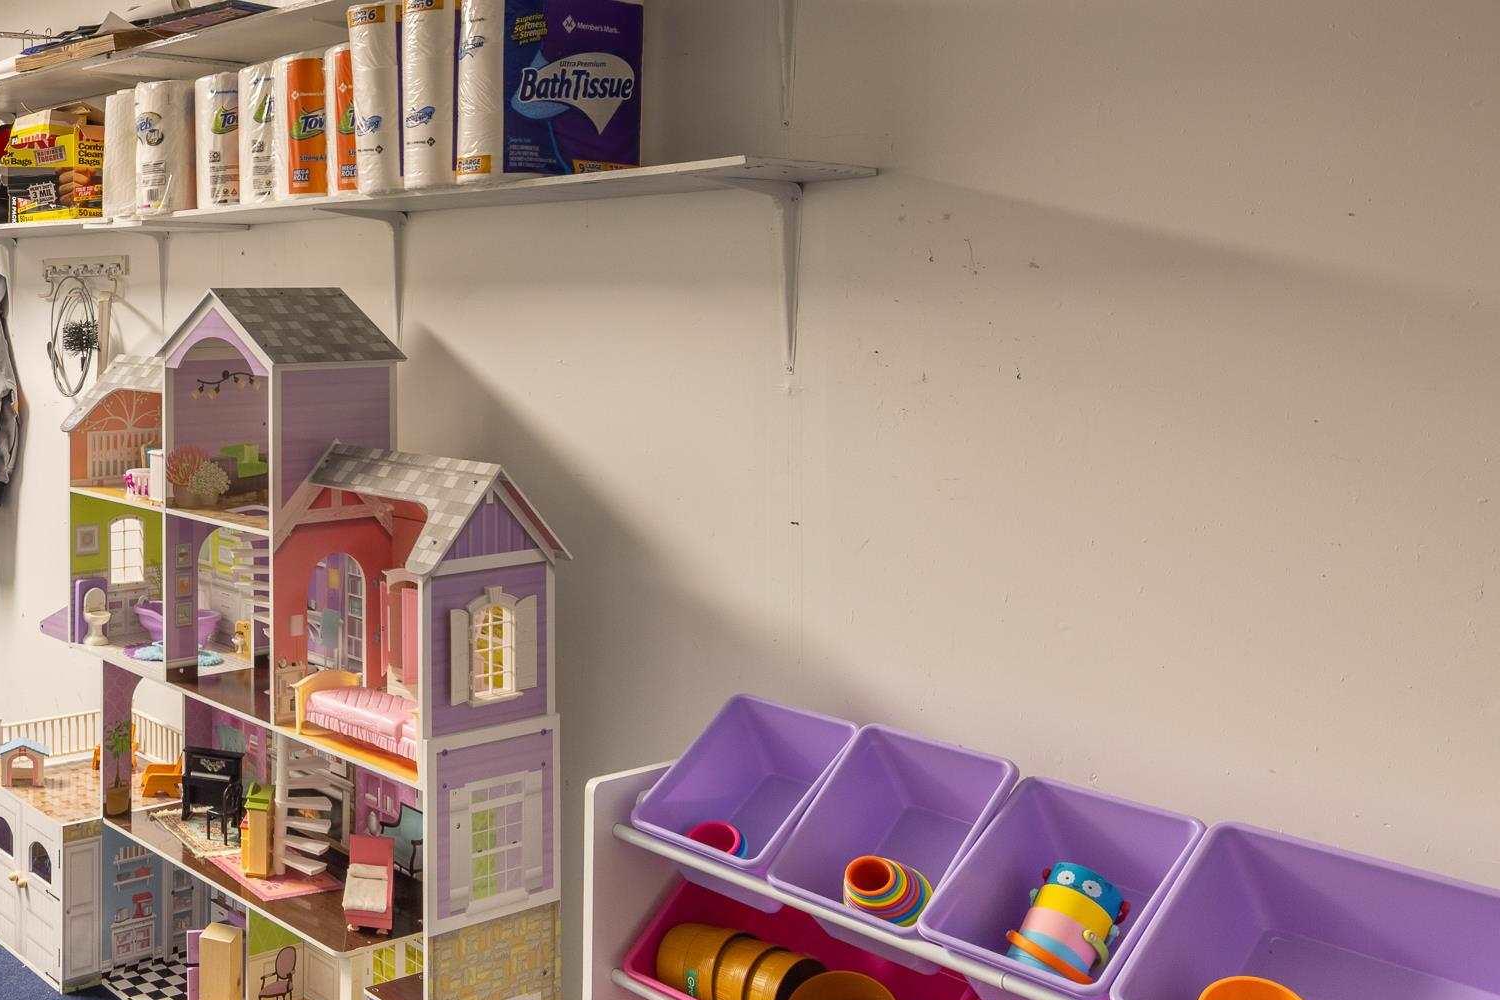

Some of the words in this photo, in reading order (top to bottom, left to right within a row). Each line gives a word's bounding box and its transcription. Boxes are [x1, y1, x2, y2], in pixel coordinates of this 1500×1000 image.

[559, 60, 575, 68] Ultra
[576, 60, 607, 68] Premium
[78, 157, 101, 166] Bags
[40, 189, 53, 198] MIL
